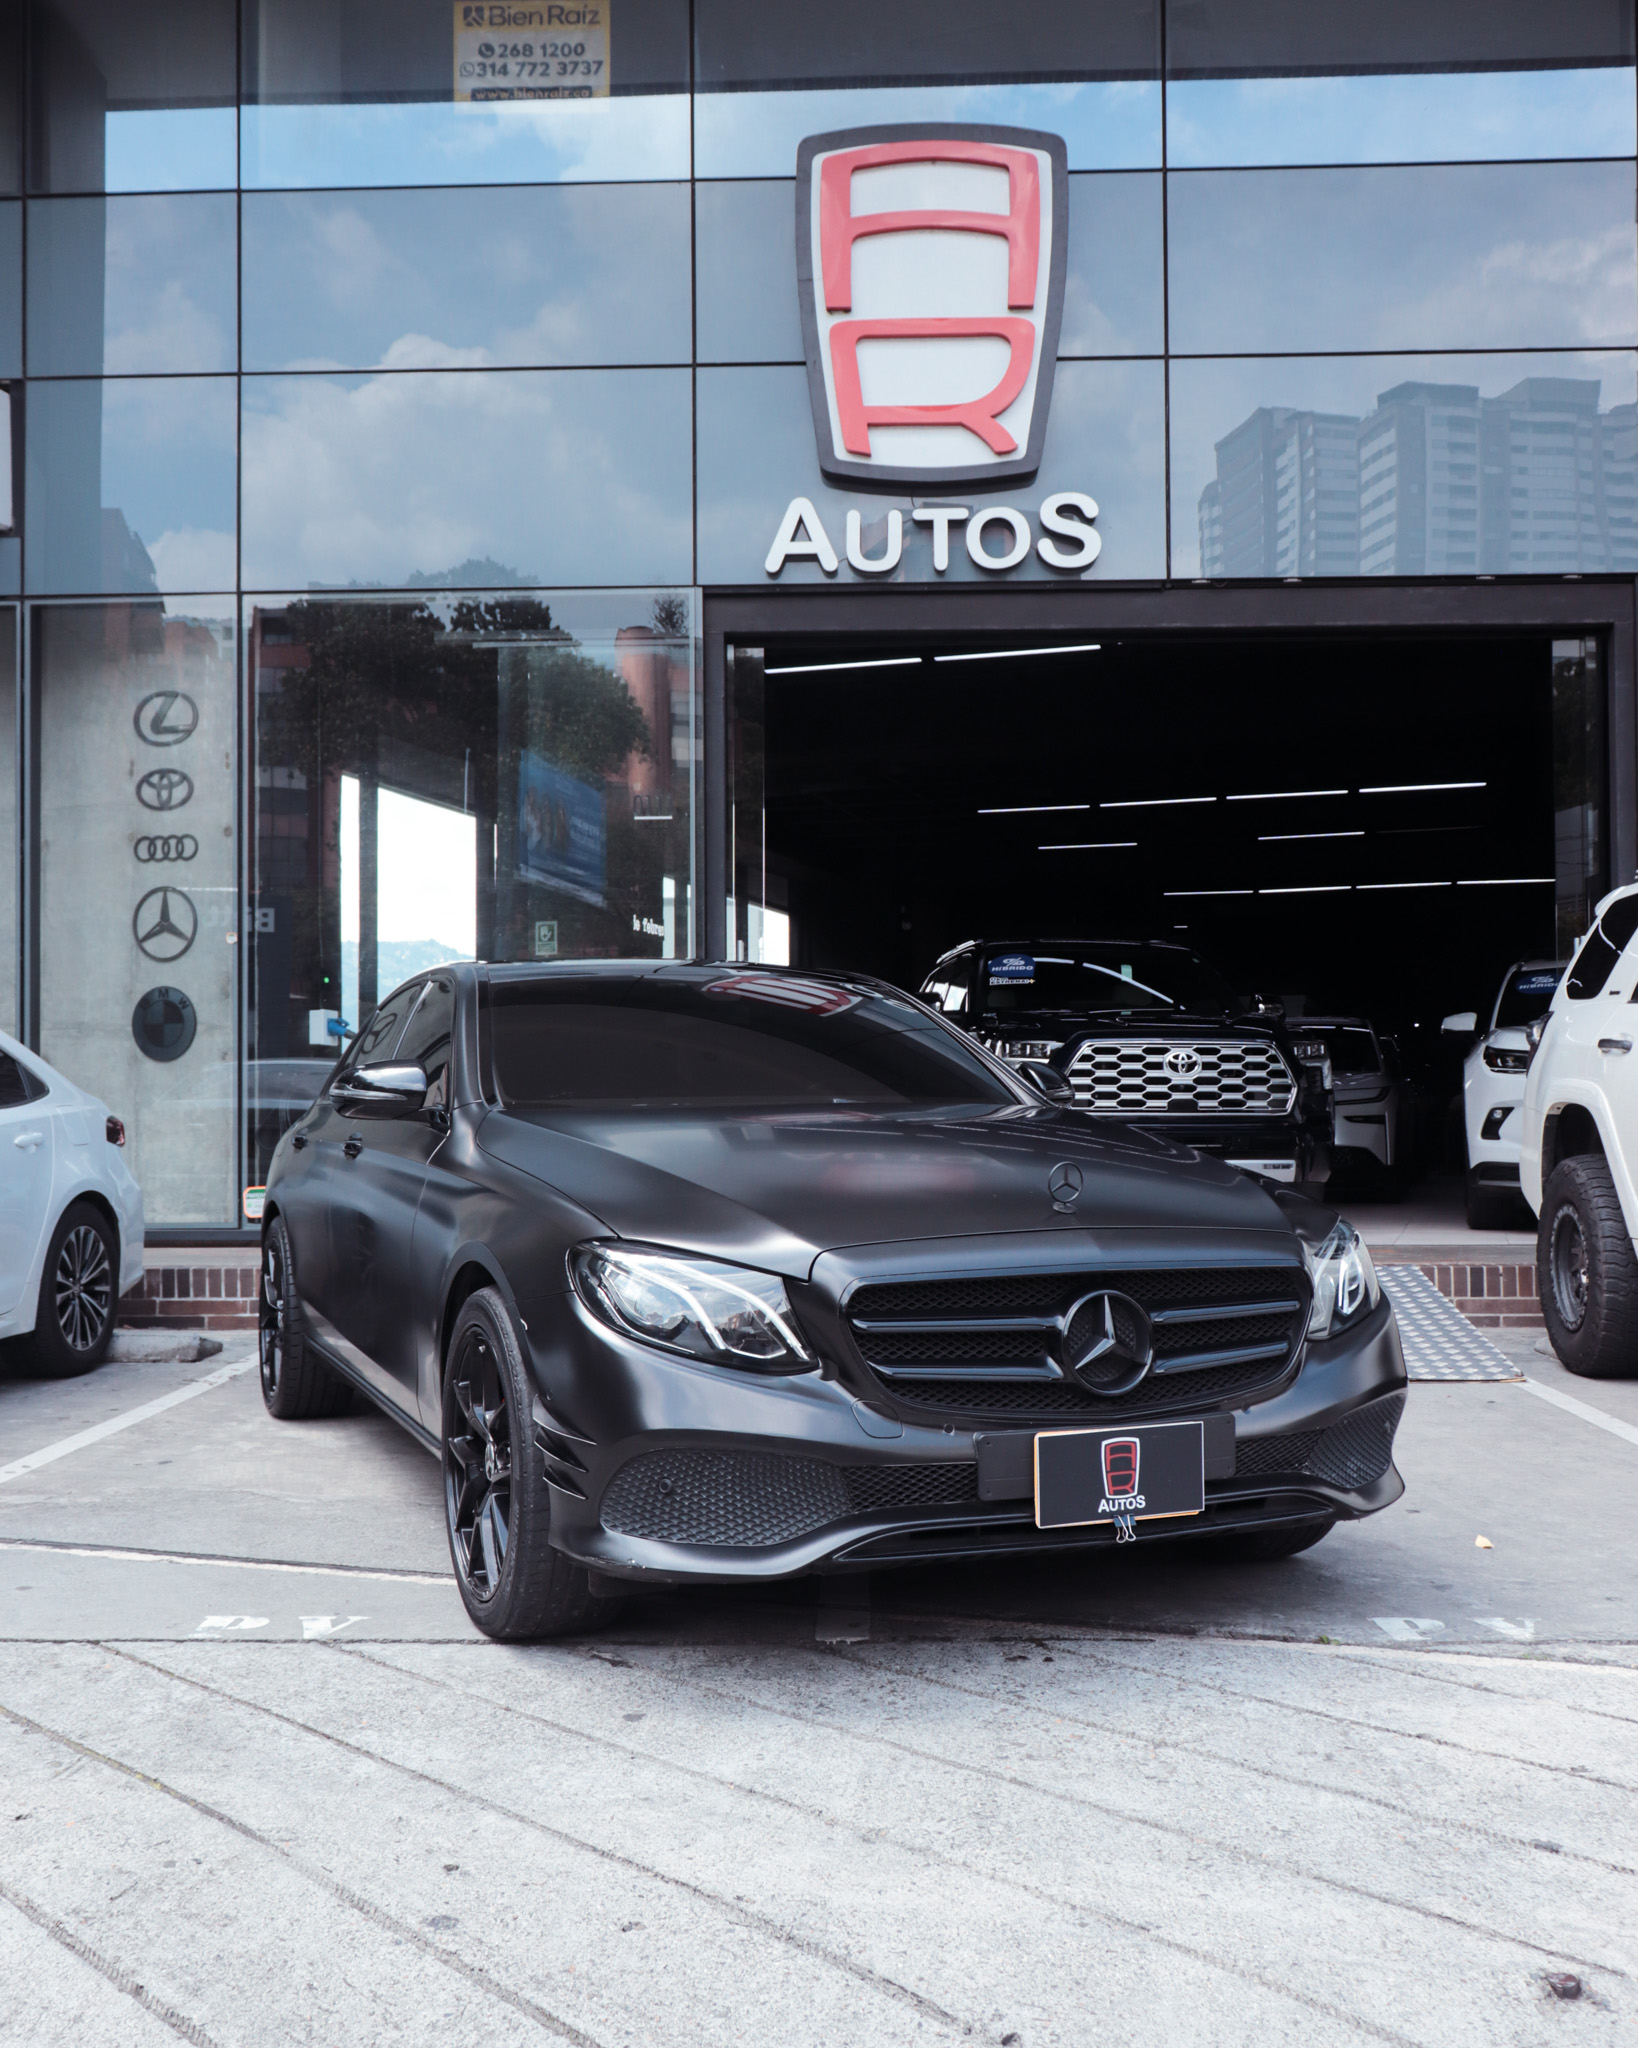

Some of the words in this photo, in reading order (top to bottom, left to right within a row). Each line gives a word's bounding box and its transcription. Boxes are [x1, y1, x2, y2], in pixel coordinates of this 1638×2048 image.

[488, 5, 544, 27] Bien
[547, 4, 600, 26] Raíz
[498, 43, 534, 58] 268
[540, 42, 586, 57] 1200
[476, 62, 508, 77] 314
[515, 61, 550, 77] 772
[557, 60, 604, 76] 3737
[764, 491, 1102, 575] AUTOS
[1098, 1495, 1146, 1513] AUTOS
